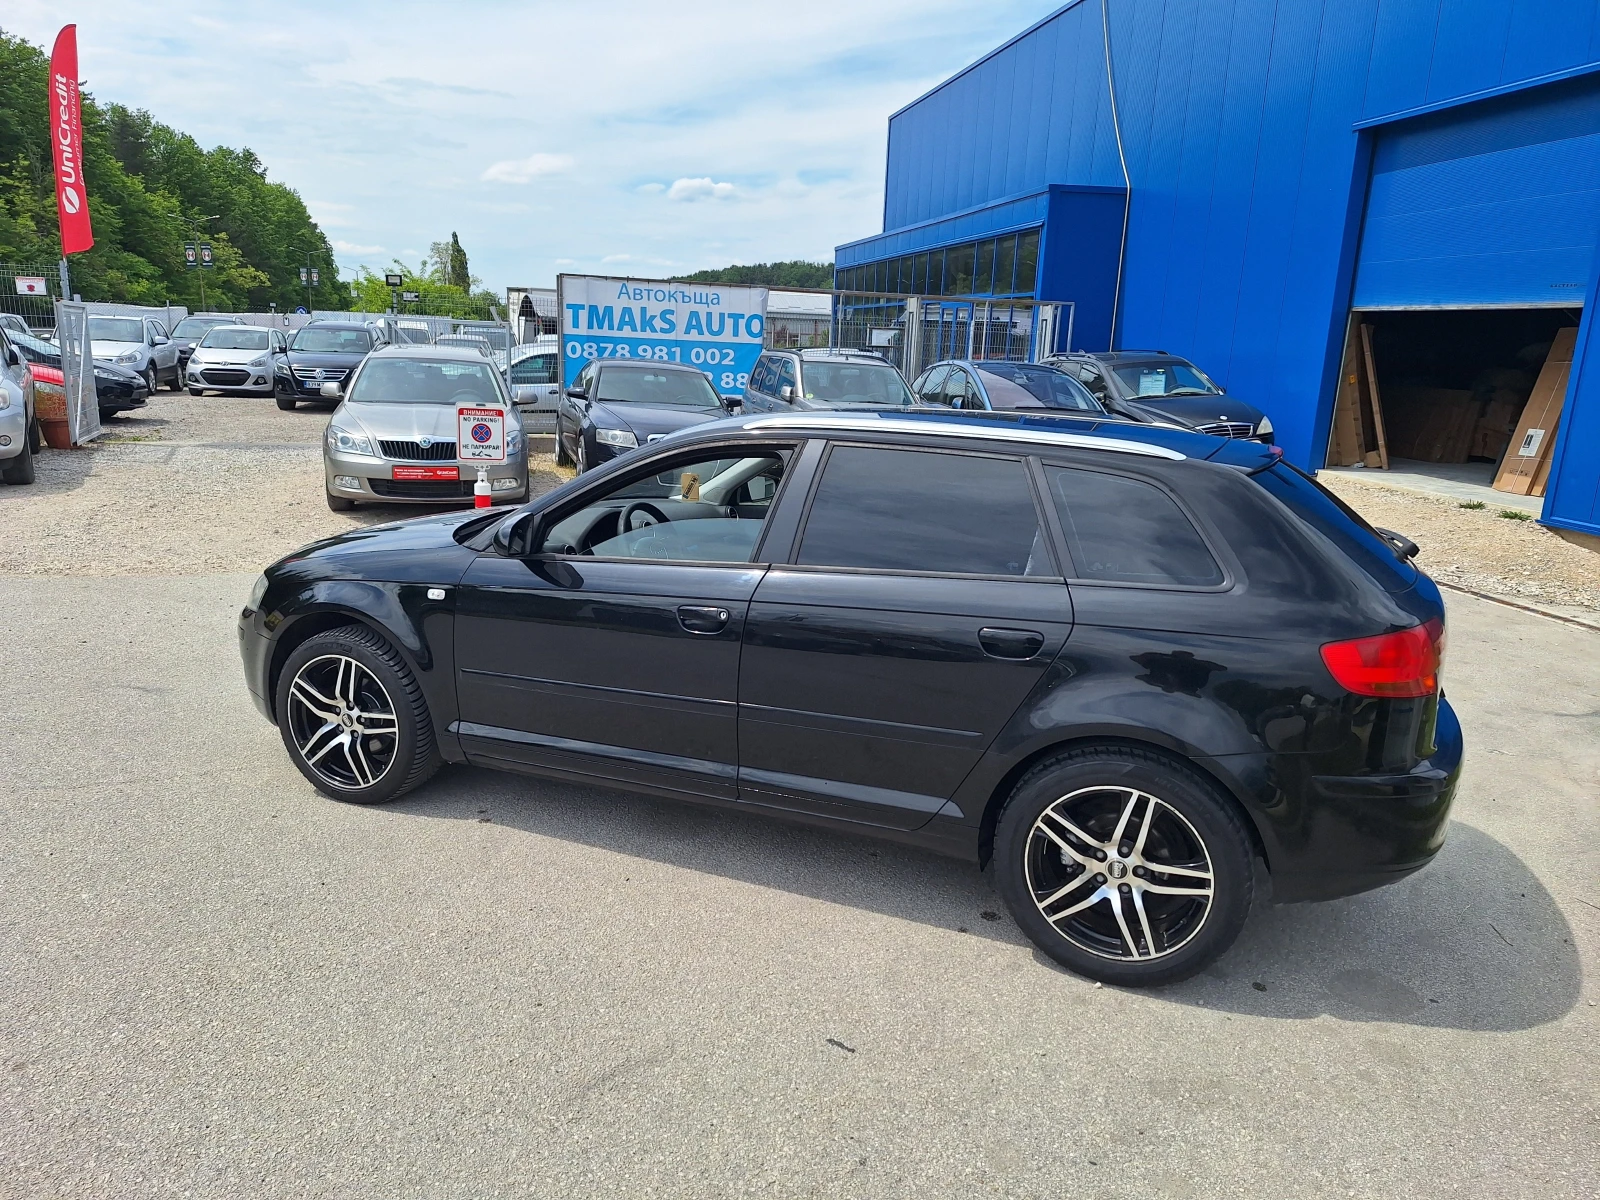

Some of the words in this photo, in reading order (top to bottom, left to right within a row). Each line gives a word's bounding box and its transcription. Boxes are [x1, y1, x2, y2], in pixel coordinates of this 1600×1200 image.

[69, 80, 77, 130] Financing
[55, 73, 76, 184] UniCredit
[617, 283, 721, 308] Автокъща
[566, 303, 676, 334] TMAkS
[683, 310, 764, 339] AUTO
[566, 341, 631, 359] 0878
[637, 344, 681, 362] 981
[690, 348, 735, 366] 002
[720, 371, 749, 389] 88
